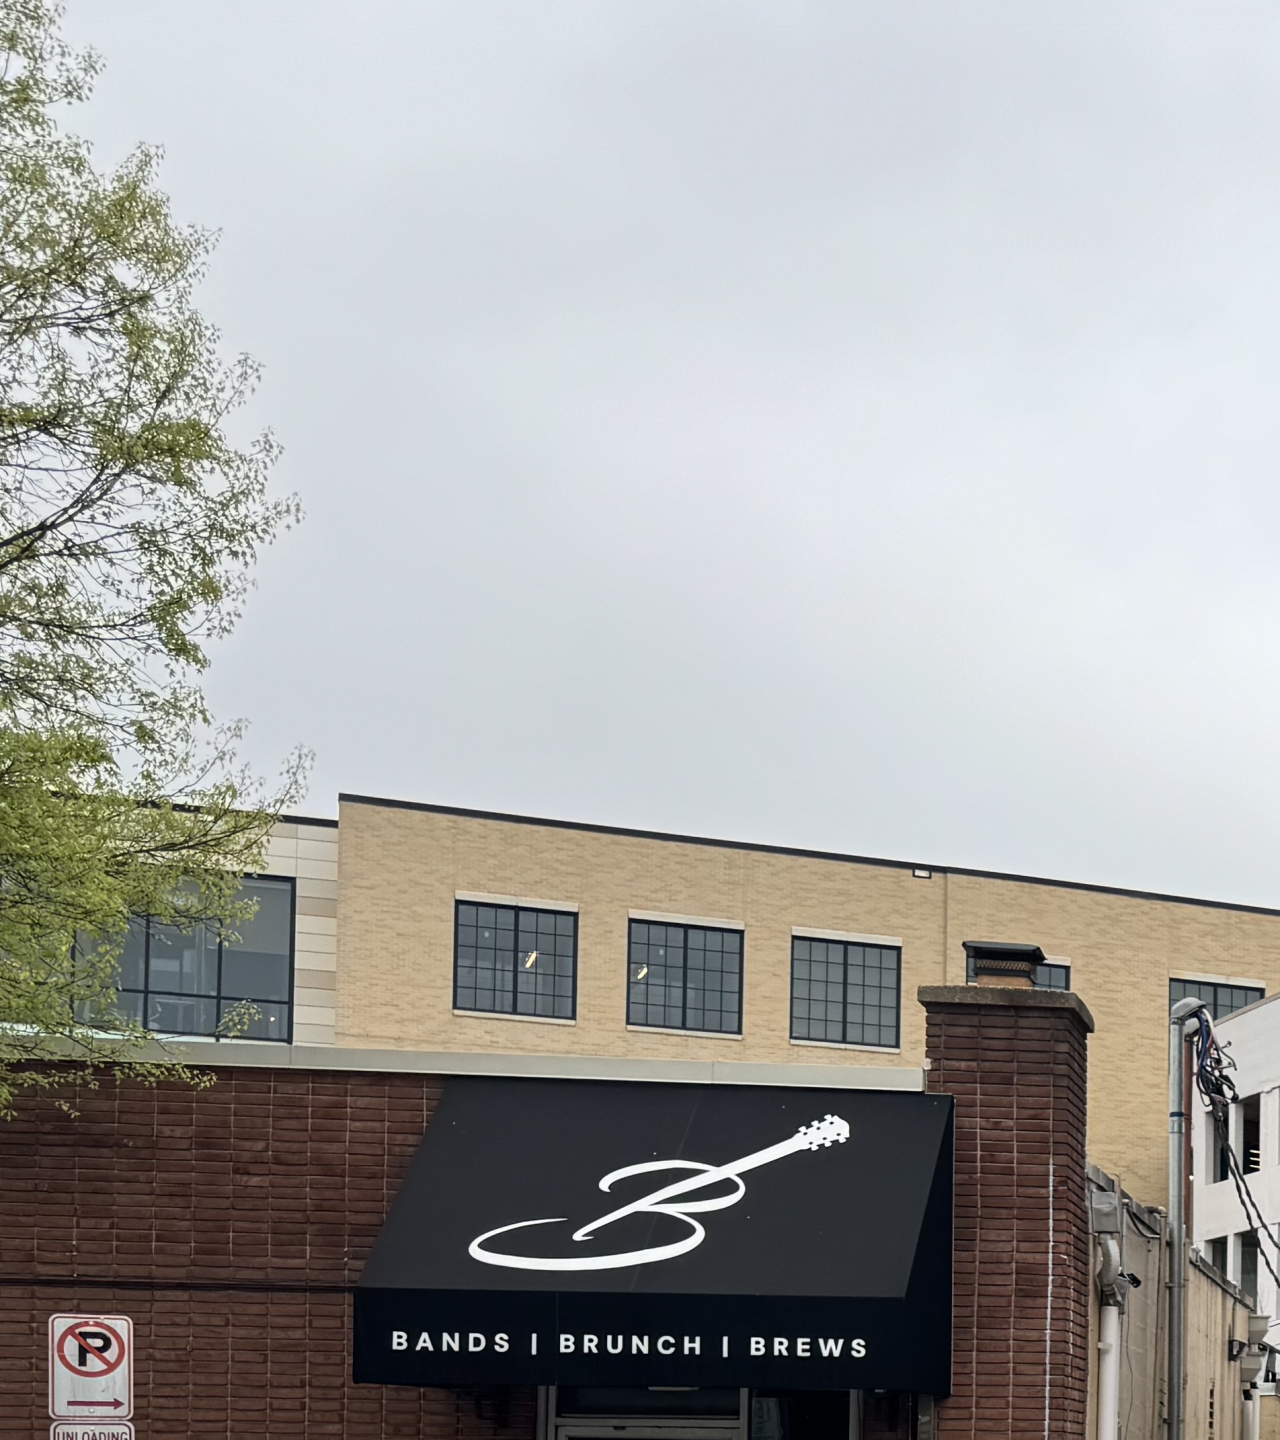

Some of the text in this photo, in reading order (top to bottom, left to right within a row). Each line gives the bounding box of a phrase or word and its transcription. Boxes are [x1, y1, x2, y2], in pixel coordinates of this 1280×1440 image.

[391, 1330, 511, 1353] BANDS
[558, 1334, 702, 1356] BRUNCH
[749, 1337, 868, 1358] BREWS
